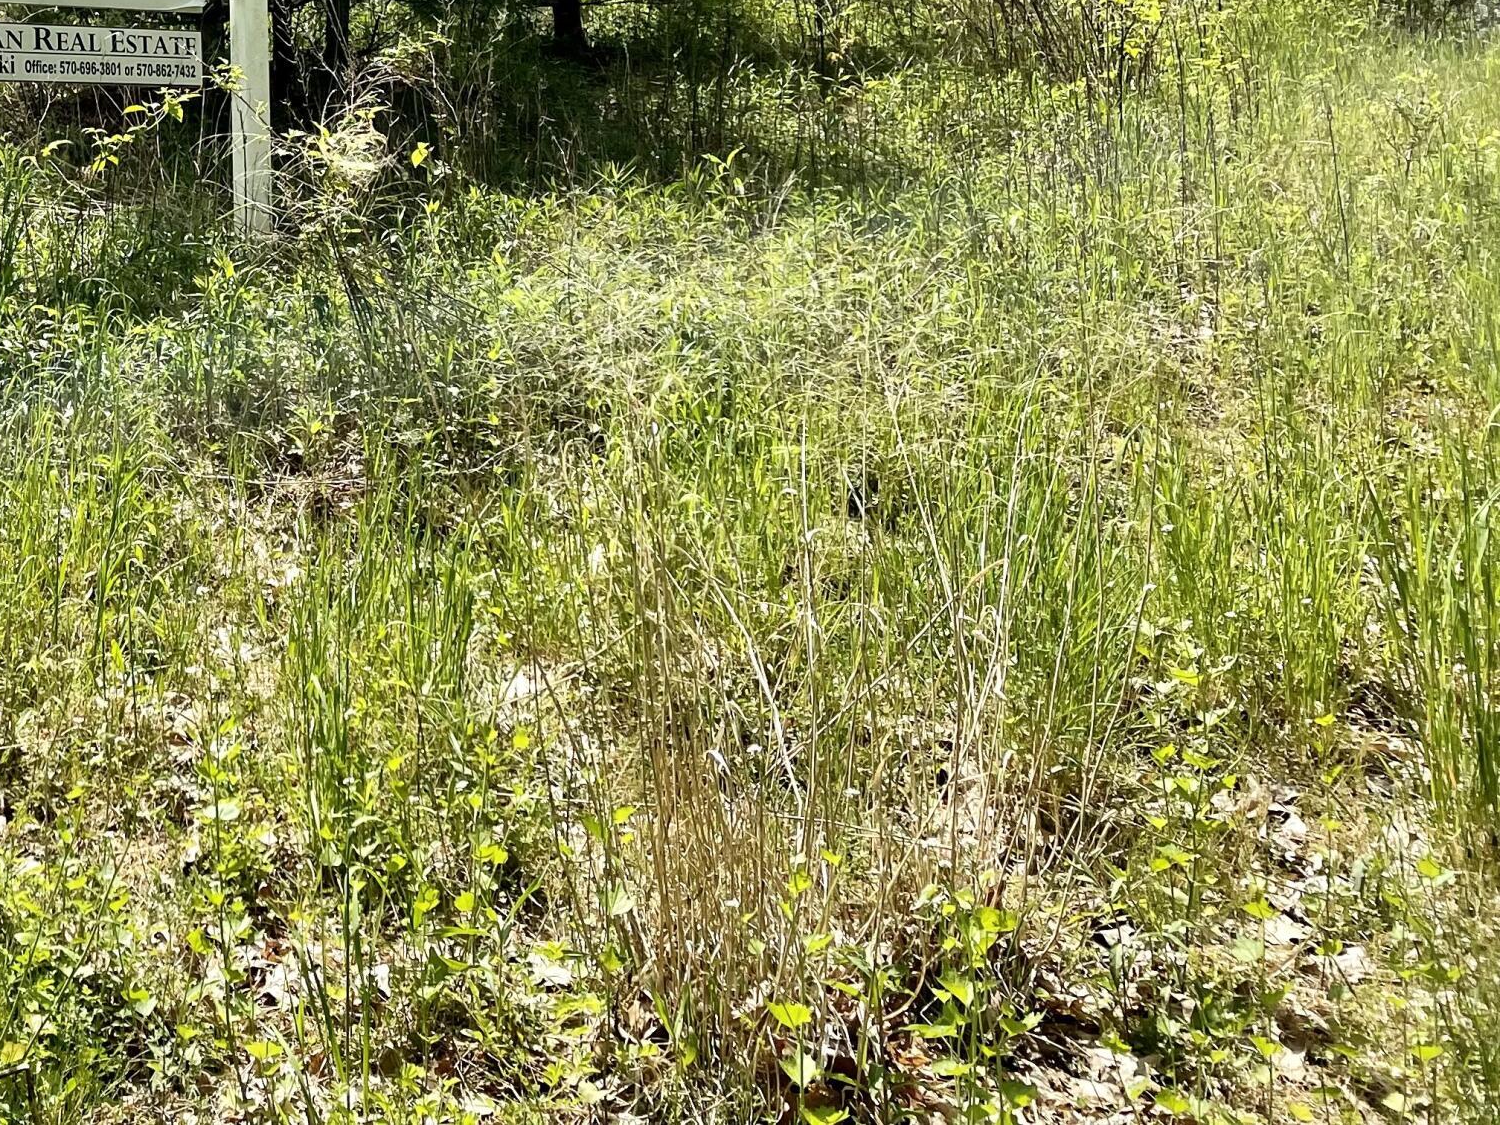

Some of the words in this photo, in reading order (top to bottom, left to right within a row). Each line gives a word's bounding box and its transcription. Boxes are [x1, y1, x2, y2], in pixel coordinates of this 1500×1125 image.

[33, 26, 102, 53] REAL
[109, 30, 197, 56] ESTATE
[24, 59, 57, 74] Office:
[59, 60, 122, 76] 570-696-3801
[124, 65, 135, 76] or
[136, 63, 197, 78] 570-862-7432
